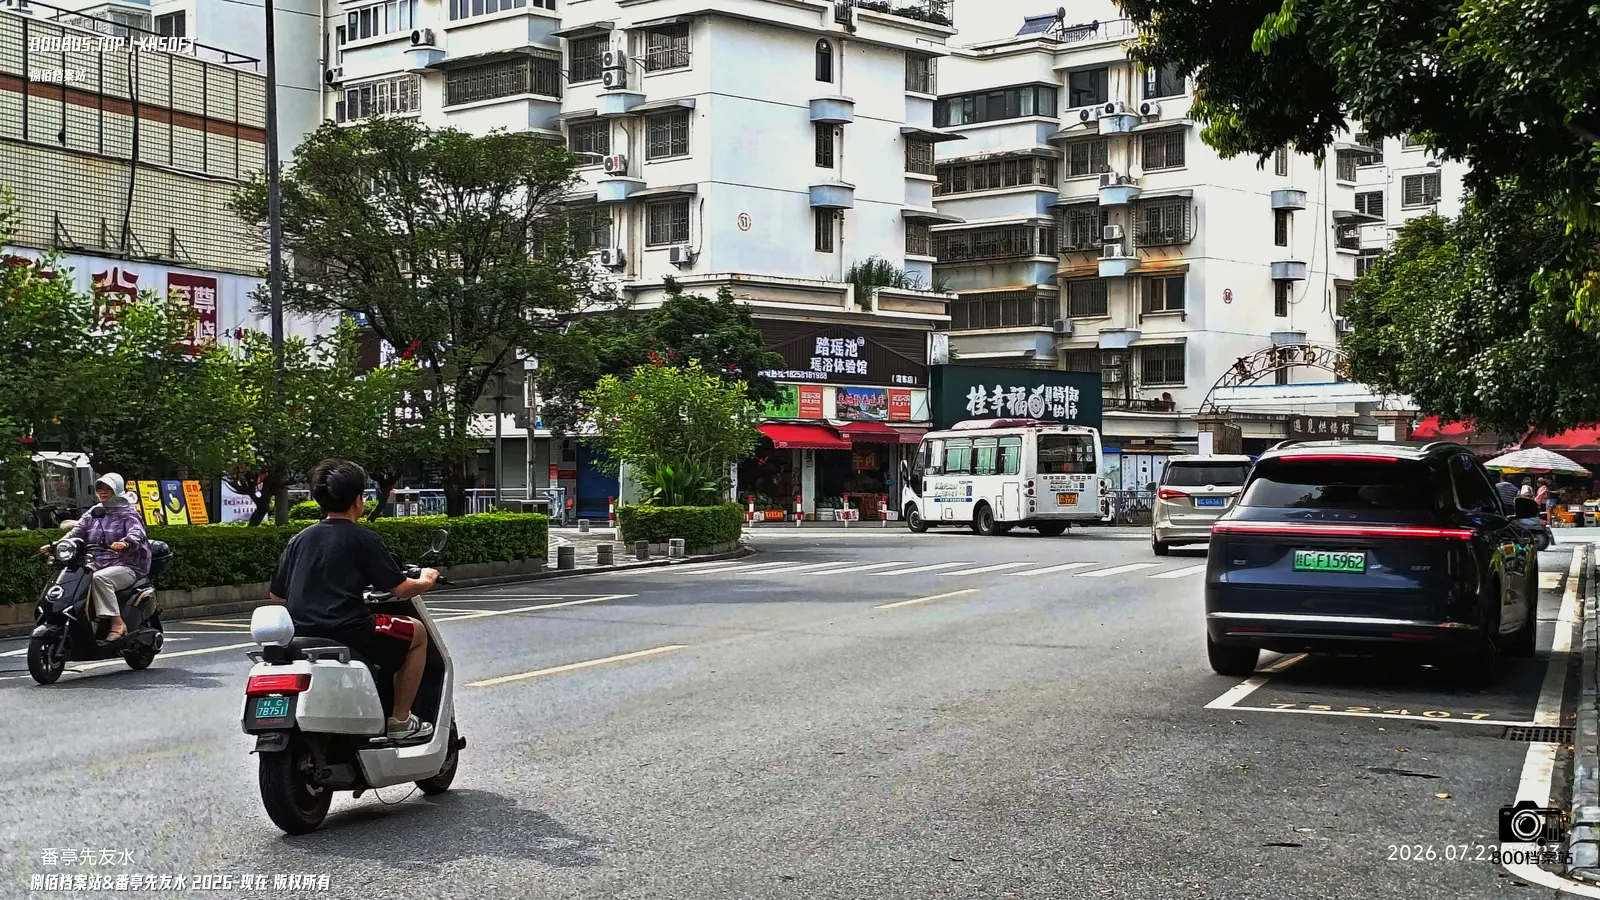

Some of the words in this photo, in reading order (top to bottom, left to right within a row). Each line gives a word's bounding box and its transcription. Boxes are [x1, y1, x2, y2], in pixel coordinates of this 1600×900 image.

[815, 336, 858, 357] 踏瑶池
[810, 357, 868, 375] 瑶浴体验馆
[966, 384, 1028, 417] 桂幸福
